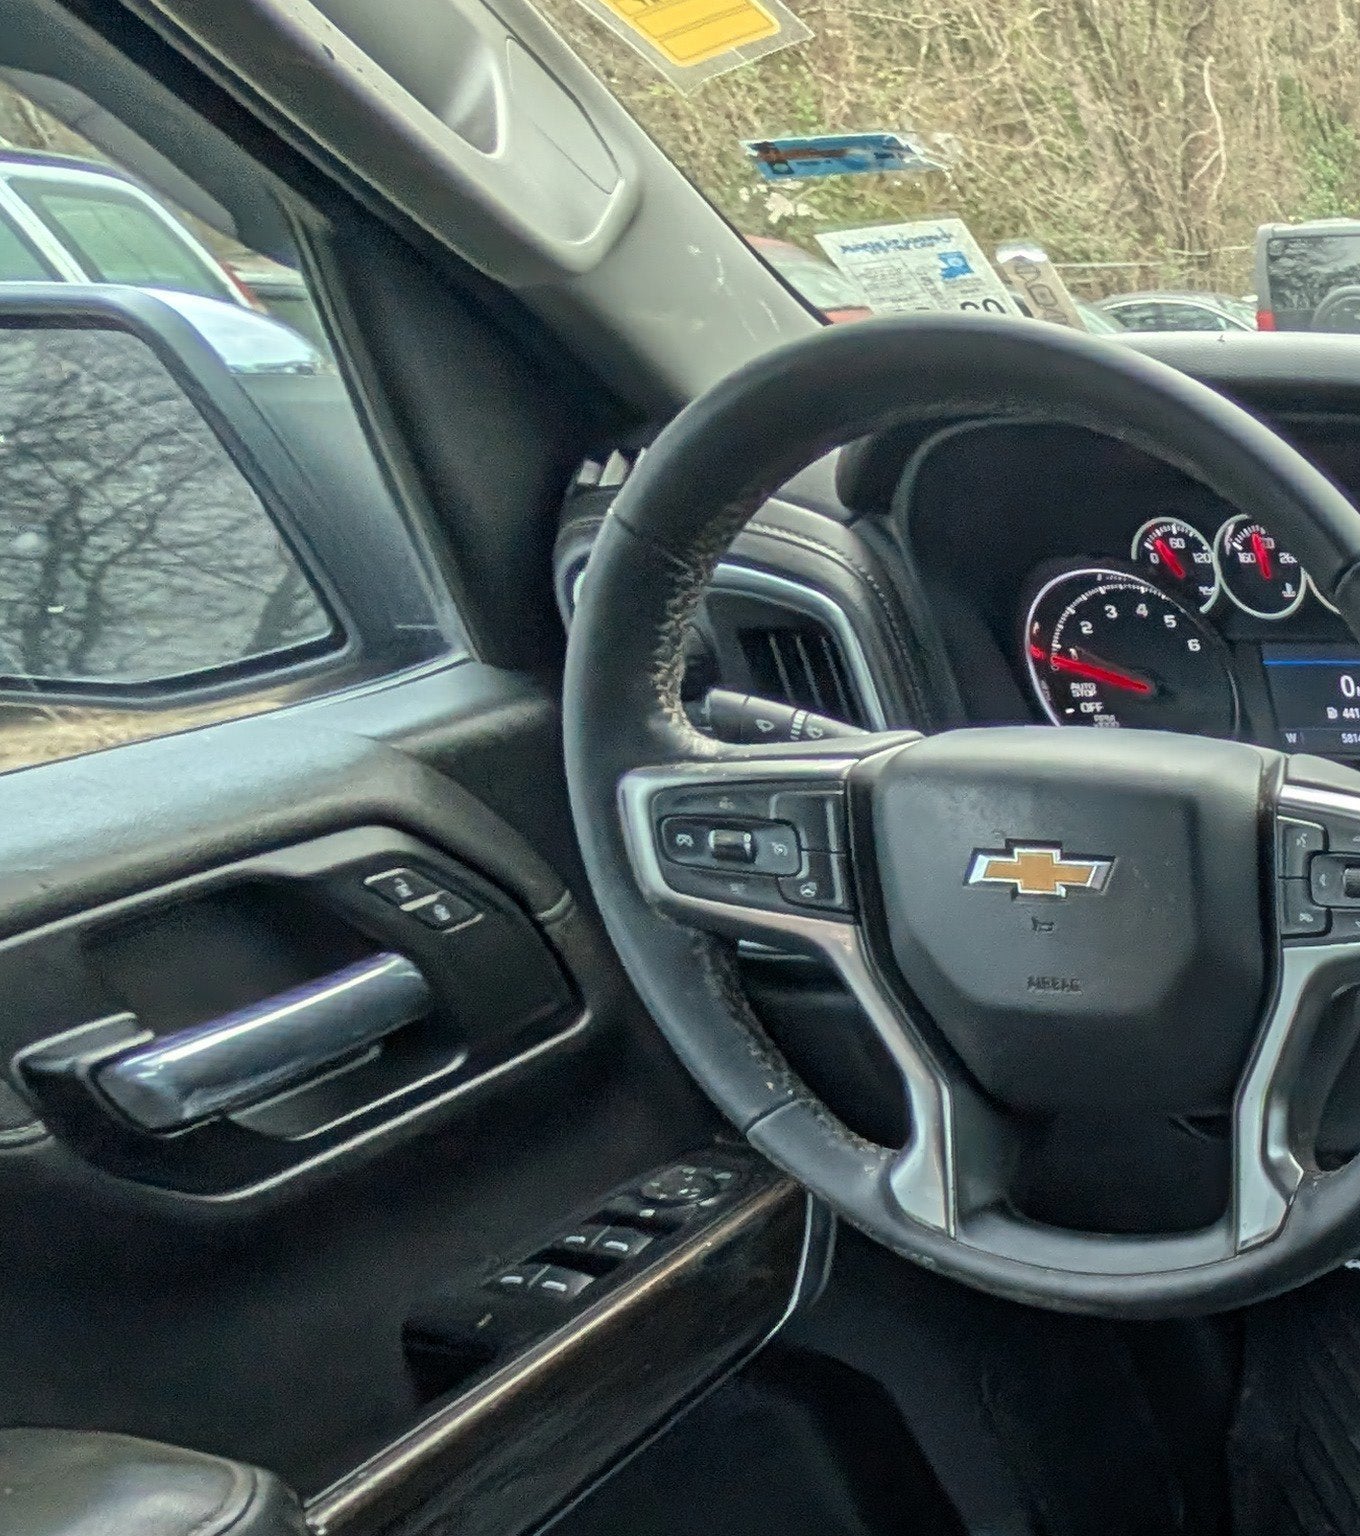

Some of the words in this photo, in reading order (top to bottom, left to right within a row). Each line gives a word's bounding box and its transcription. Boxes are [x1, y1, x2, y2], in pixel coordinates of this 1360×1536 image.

[1169, 537, 1186, 549] 60
[1150, 552, 1160, 564] 0
[1192, 552, 1212, 564] 120
[1237, 552, 1256, 564] 160
[1104, 604, 1118, 619] 3
[1135, 603, 1149, 618] 4
[1079, 620, 1094, 634] 2
[1163, 614, 1177, 629] 5
[1187, 638, 1201, 651] 6
[1340, 674, 1355, 698] 0
[1080, 701, 1104, 714] OFF
[1342, 707, 1360, 719] 441
[1285, 732, 1297, 744] W
